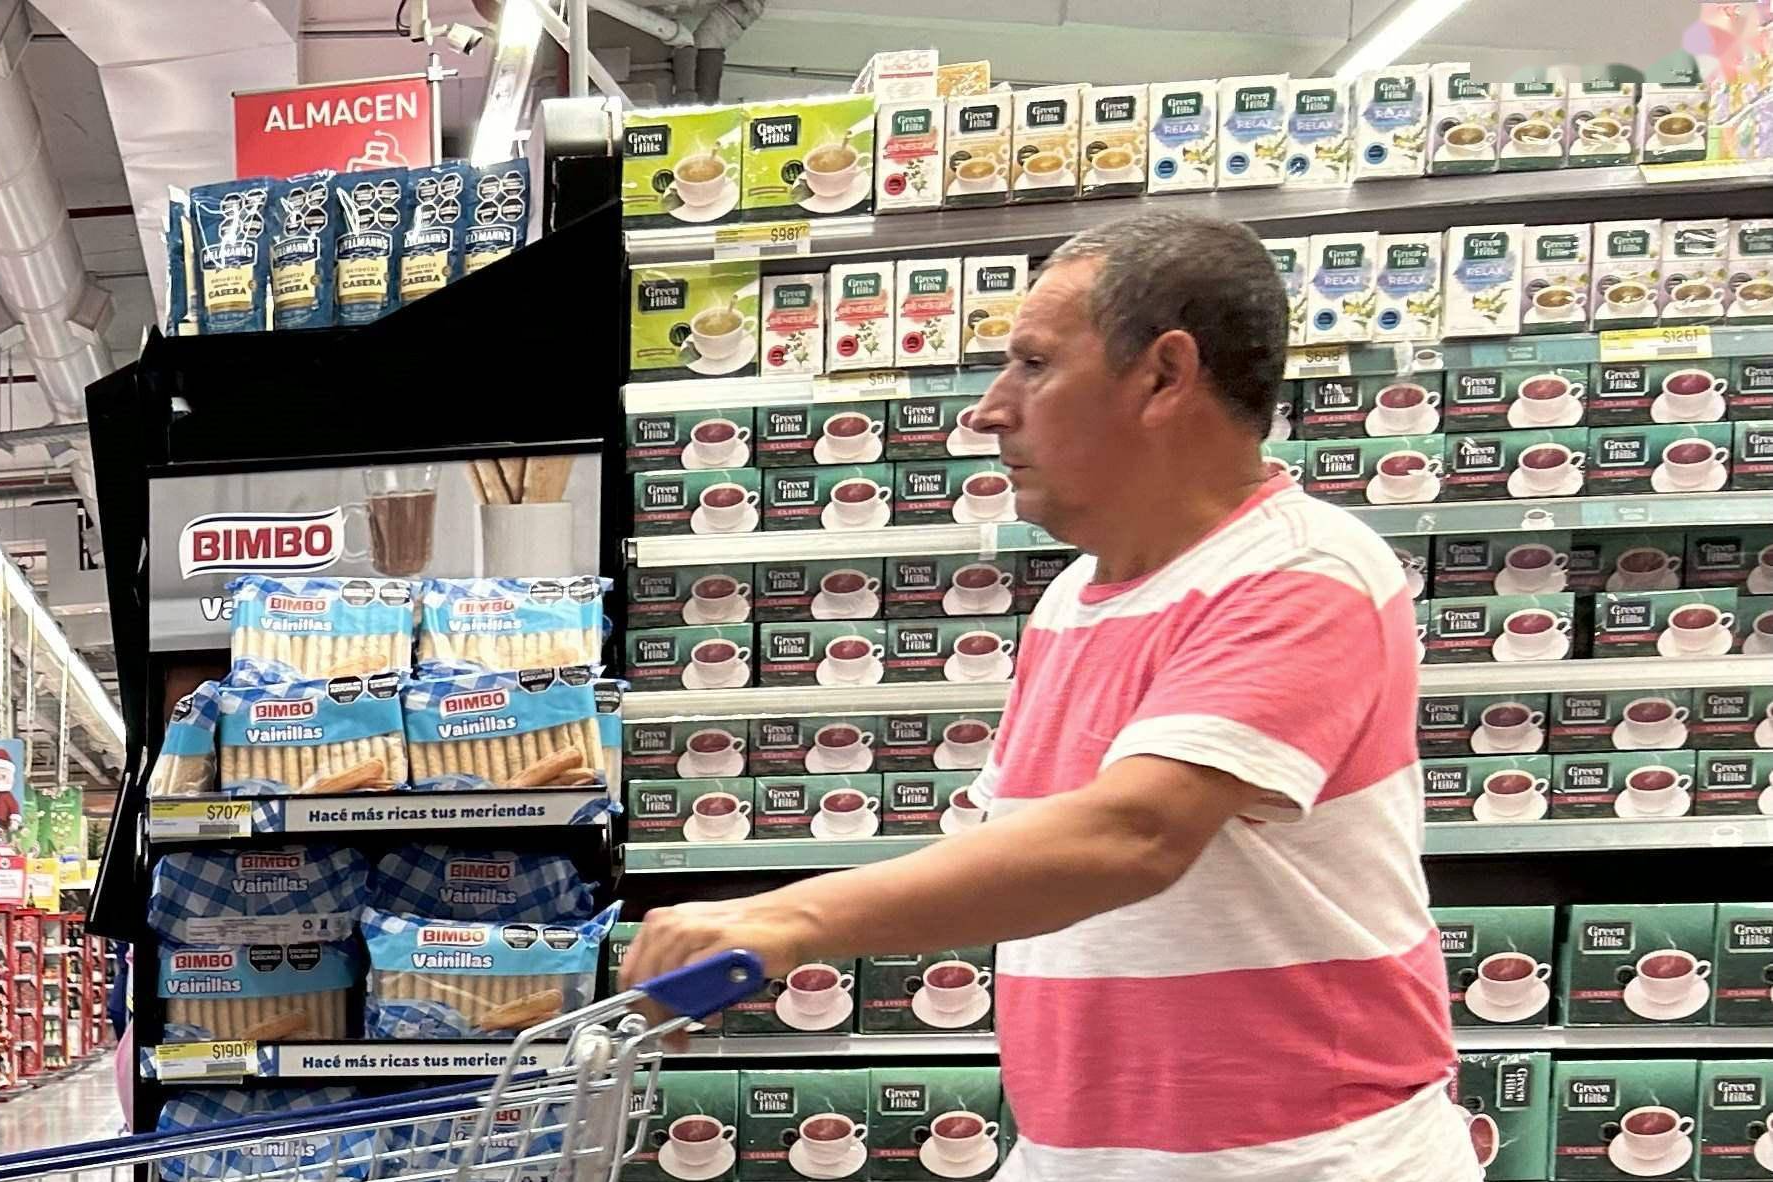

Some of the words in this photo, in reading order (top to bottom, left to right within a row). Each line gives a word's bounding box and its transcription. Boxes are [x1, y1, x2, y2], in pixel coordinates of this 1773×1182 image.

[264, 92, 418, 134] ALMACEN
[757, 122, 792, 136] Green
[1164, 123, 1201, 134] RELAX
[1236, 119, 1271, 130] RELAX
[1297, 121, 1333, 131] RELAX
[628, 132, 663, 145] Green
[762, 131, 790, 144] Hills
[634, 142, 660, 154] Hills
[1465, 266, 1504, 277] RELAX
[342, 277, 383, 289] CASERA
[402, 273, 441, 286] CASERA
[1324, 275, 1361, 286] RELAX
[1388, 275, 1425, 286] RELAX
[208, 287, 247, 299] CASERA
[644, 286, 679, 298] Green
[649, 296, 678, 308] Hills
[1460, 374, 1496, 389] Green
[1465, 385, 1495, 397] Hills
[1604, 439, 1640, 451] Green
[1319, 452, 1354, 465] Green
[1609, 449, 1638, 461] Hills
[1325, 462, 1352, 474] Hills
[192, 523, 334, 563] BIMBO
[269, 597, 327, 613] BIMBO
[259, 617, 332, 633] Vainillas
[448, 616, 522, 633] Vainillas
[1449, 619, 1478, 631] Hills
[773, 635, 805, 648] Green
[778, 645, 802, 657] Hills
[444, 692, 506, 712] BIMBO
[255, 702, 315, 719] BIMBO
[245, 724, 324, 743] Vainillas
[438, 715, 518, 739] Vainillas
[895, 783, 927, 796] Green
[900, 793, 925, 805] Hills
[308, 806, 348, 823] Hacé
[352, 805, 384, 822] más
[388, 804, 428, 821] ricas
[432, 805, 457, 820] tus
[461, 803, 546, 820] meriendas
[240, 855, 301, 869] BIMBO
[450, 864, 511, 880] BIMBO
[232, 878, 310, 894] Vainillas
[440, 889, 517, 905] Vainillas
[422, 929, 485, 943] BIMBO
[1588, 925, 1626, 939] Green
[1592, 934, 1622, 948] Hills
[174, 953, 233, 970] BIMBO
[412, 953, 494, 969] Vainillas
[166, 978, 242, 994] Vainillas
[302, 1051, 342, 1069] Hacé
[345, 1051, 377, 1069] más
[381, 1053, 420, 1069] ricas
[424, 1053, 450, 1069] tus
[1571, 1081, 1610, 1095] Green
[1717, 1080, 1755, 1094] Green
[754, 1090, 788, 1102] Green
[885, 1088, 920, 1101] Green
[1577, 1091, 1607, 1104] Hills
[1723, 1091, 1753, 1103] Hills
[759, 1100, 787, 1111] Hills
[890, 1097, 917, 1110] Hills
